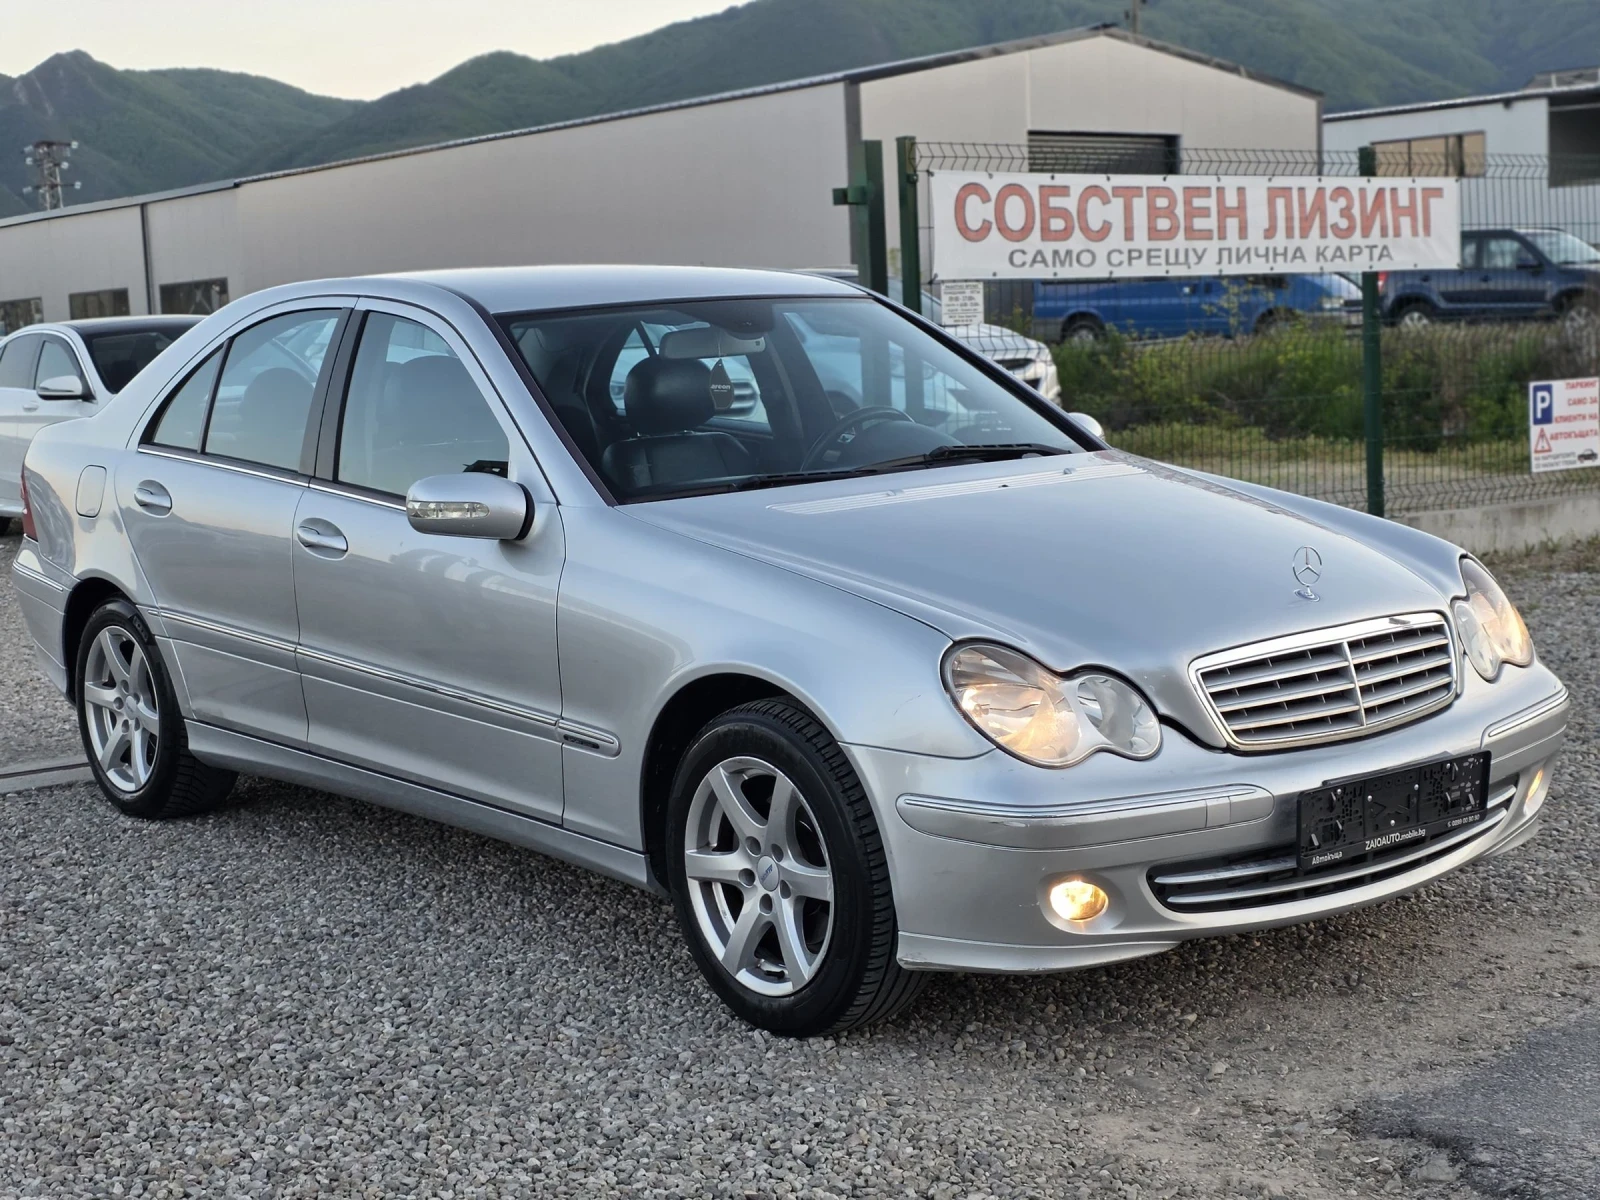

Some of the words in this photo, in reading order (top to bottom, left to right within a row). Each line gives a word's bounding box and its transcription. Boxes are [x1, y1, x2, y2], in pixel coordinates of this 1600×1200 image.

[954, 182, 1248, 243] СОБСТВЕН
[1263, 186, 1444, 240] ЛИЗИНГ
[1008, 248, 1097, 269] САМО
[1106, 247, 1208, 269] СРЕЩУ
[1215, 246, 1307, 265] ЛИЧНА
[1315, 244, 1394, 263] КАРТА
